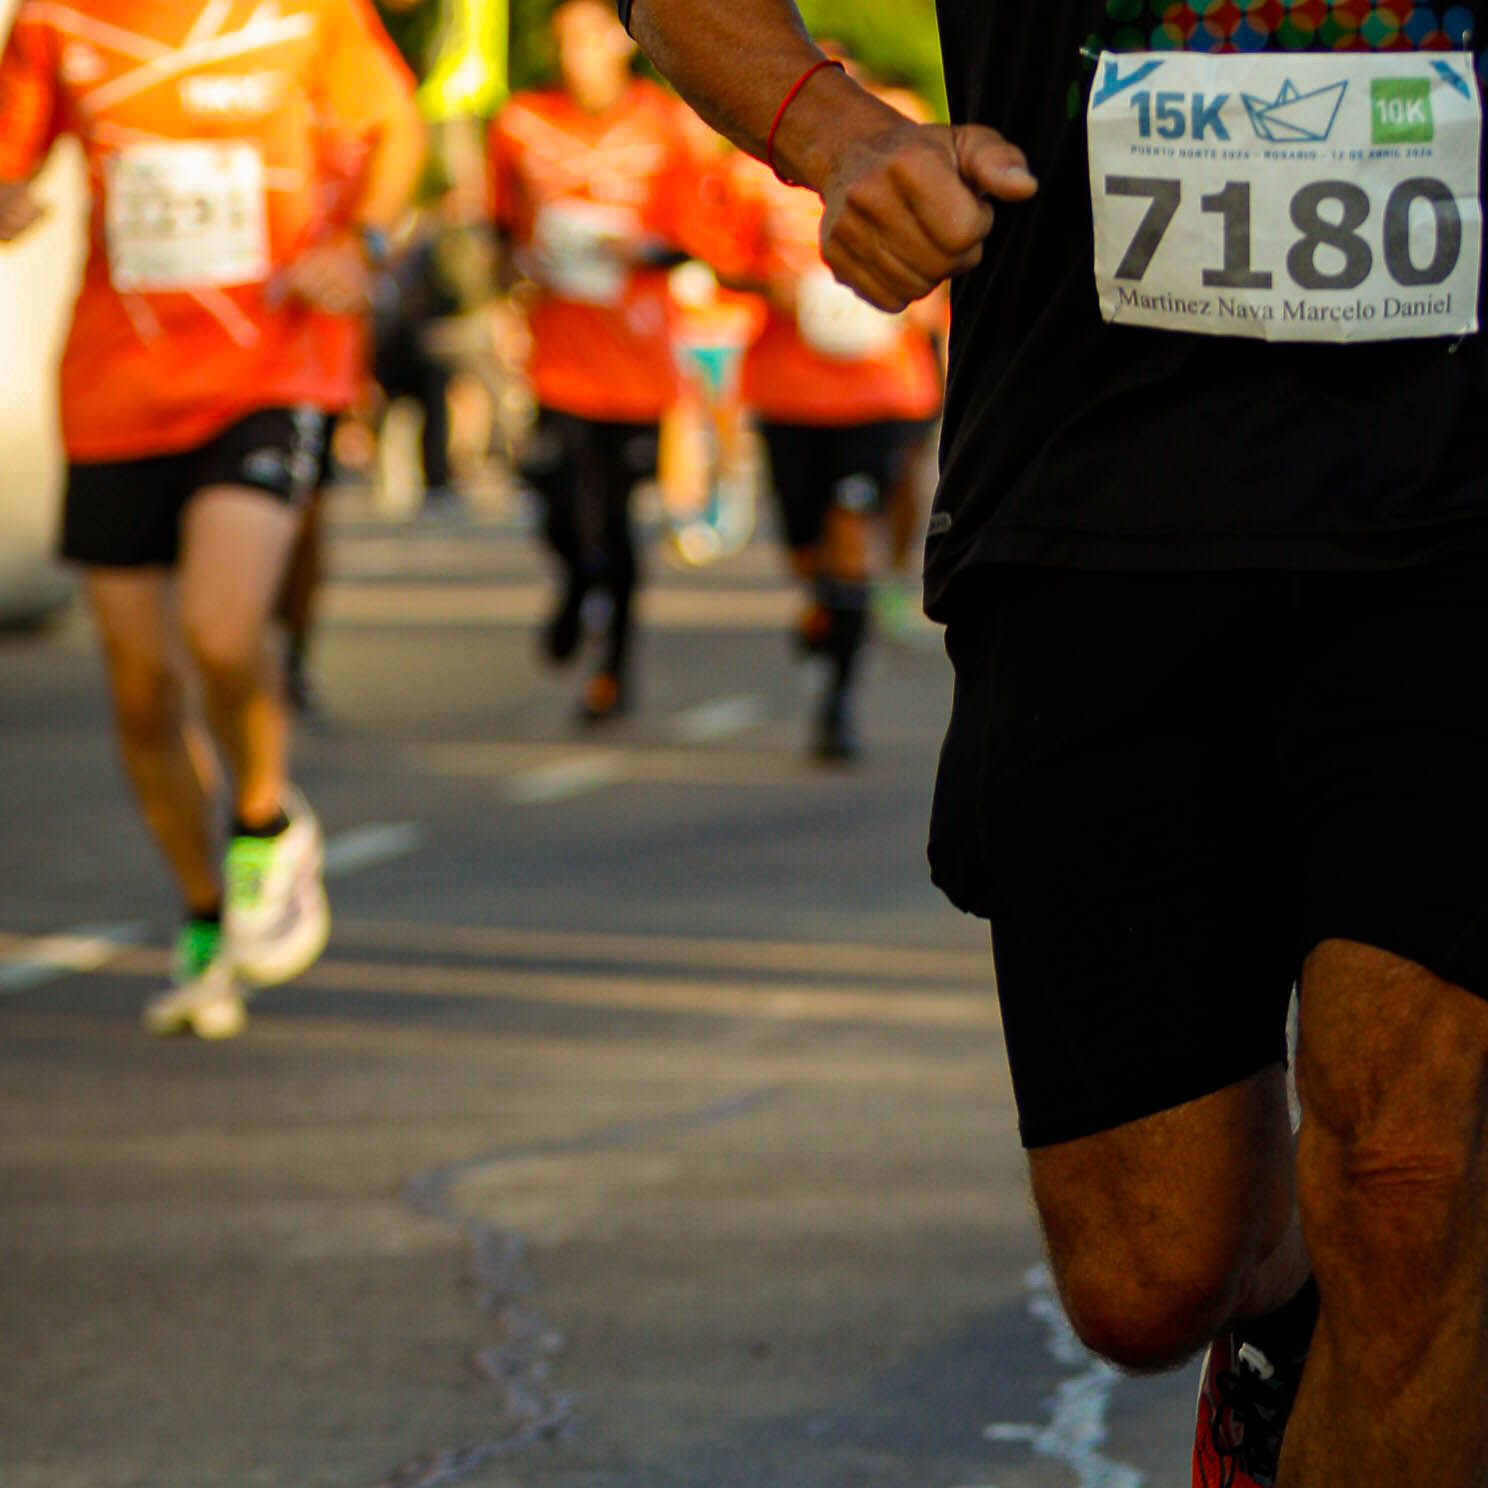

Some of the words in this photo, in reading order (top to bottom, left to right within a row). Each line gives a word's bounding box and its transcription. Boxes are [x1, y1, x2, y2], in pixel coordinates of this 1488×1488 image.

[1129, 90, 1231, 141] 15K
[1377, 97, 1426, 124] 10K
[1104, 175, 1463, 291] 7180
[1117, 287, 1212, 316] Martinez
[1217, 296, 1274, 321] Nava
[1282, 299, 1375, 321] Marcelo
[1383, 292, 1452, 319] Daniel
